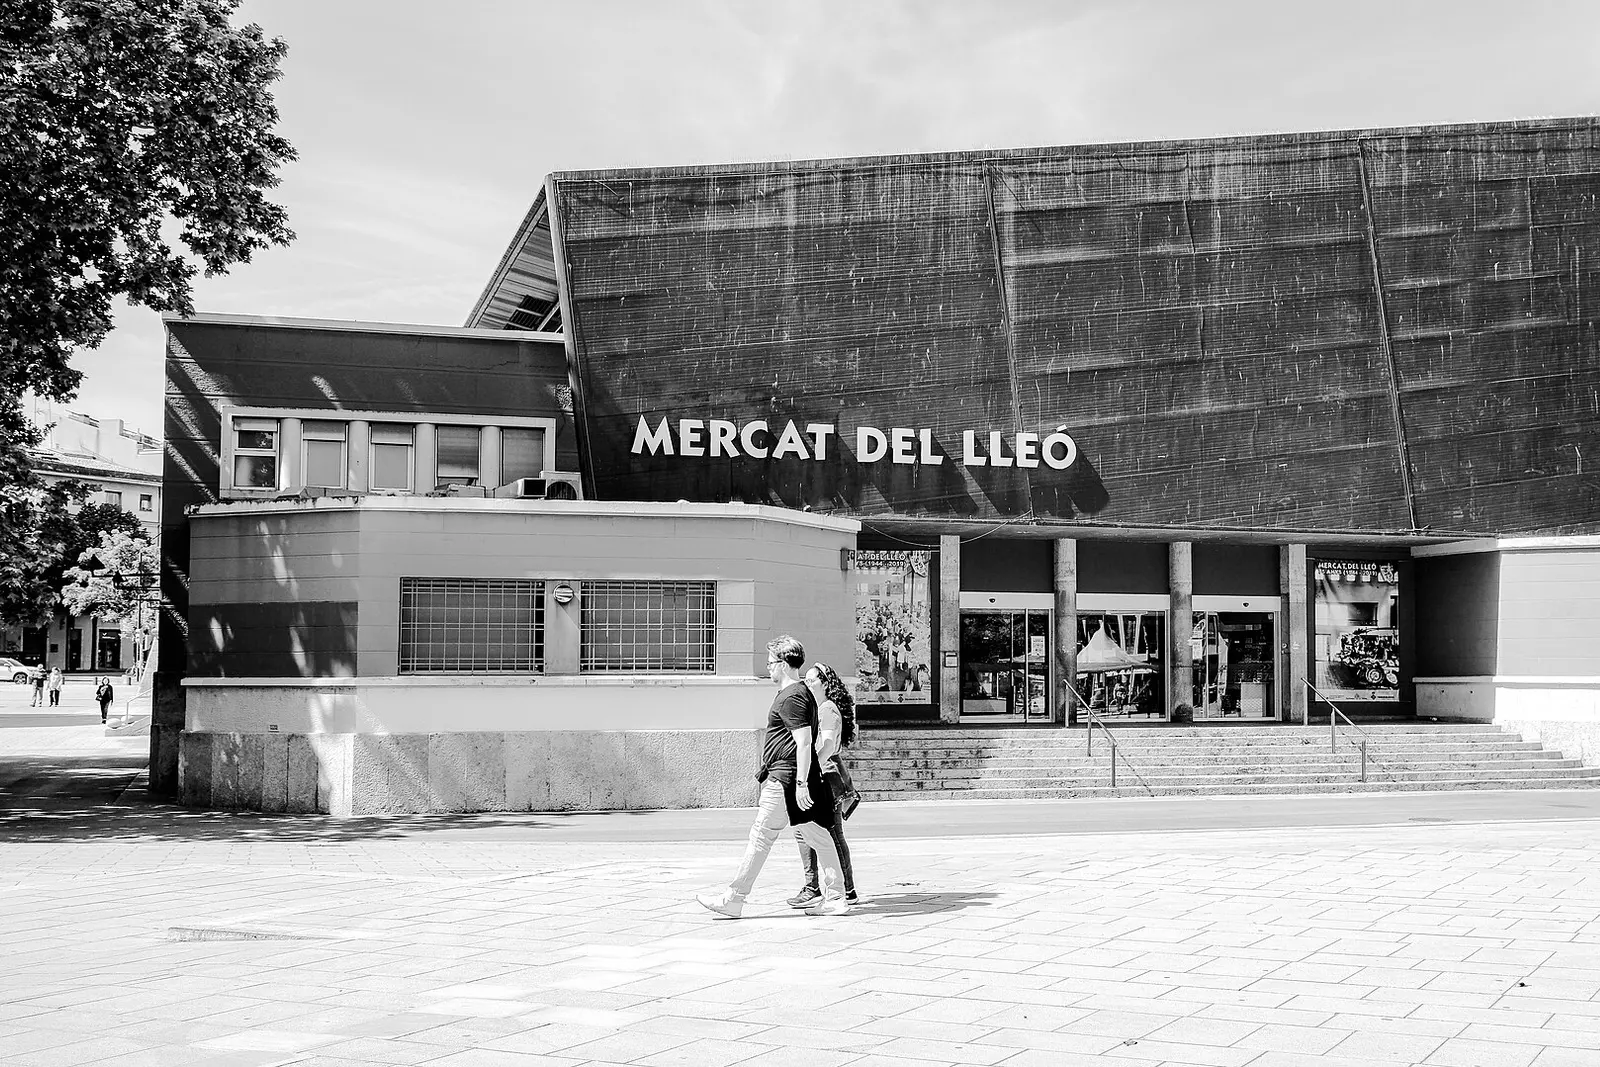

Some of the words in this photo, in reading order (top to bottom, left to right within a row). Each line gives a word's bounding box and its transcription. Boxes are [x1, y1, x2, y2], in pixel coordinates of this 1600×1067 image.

[631, 414, 834, 460] MERCAT
[857, 426, 944, 465] DEL
[963, 424, 1077, 470] LLEÓ
[1317, 562, 1346, 570] MERCAT
